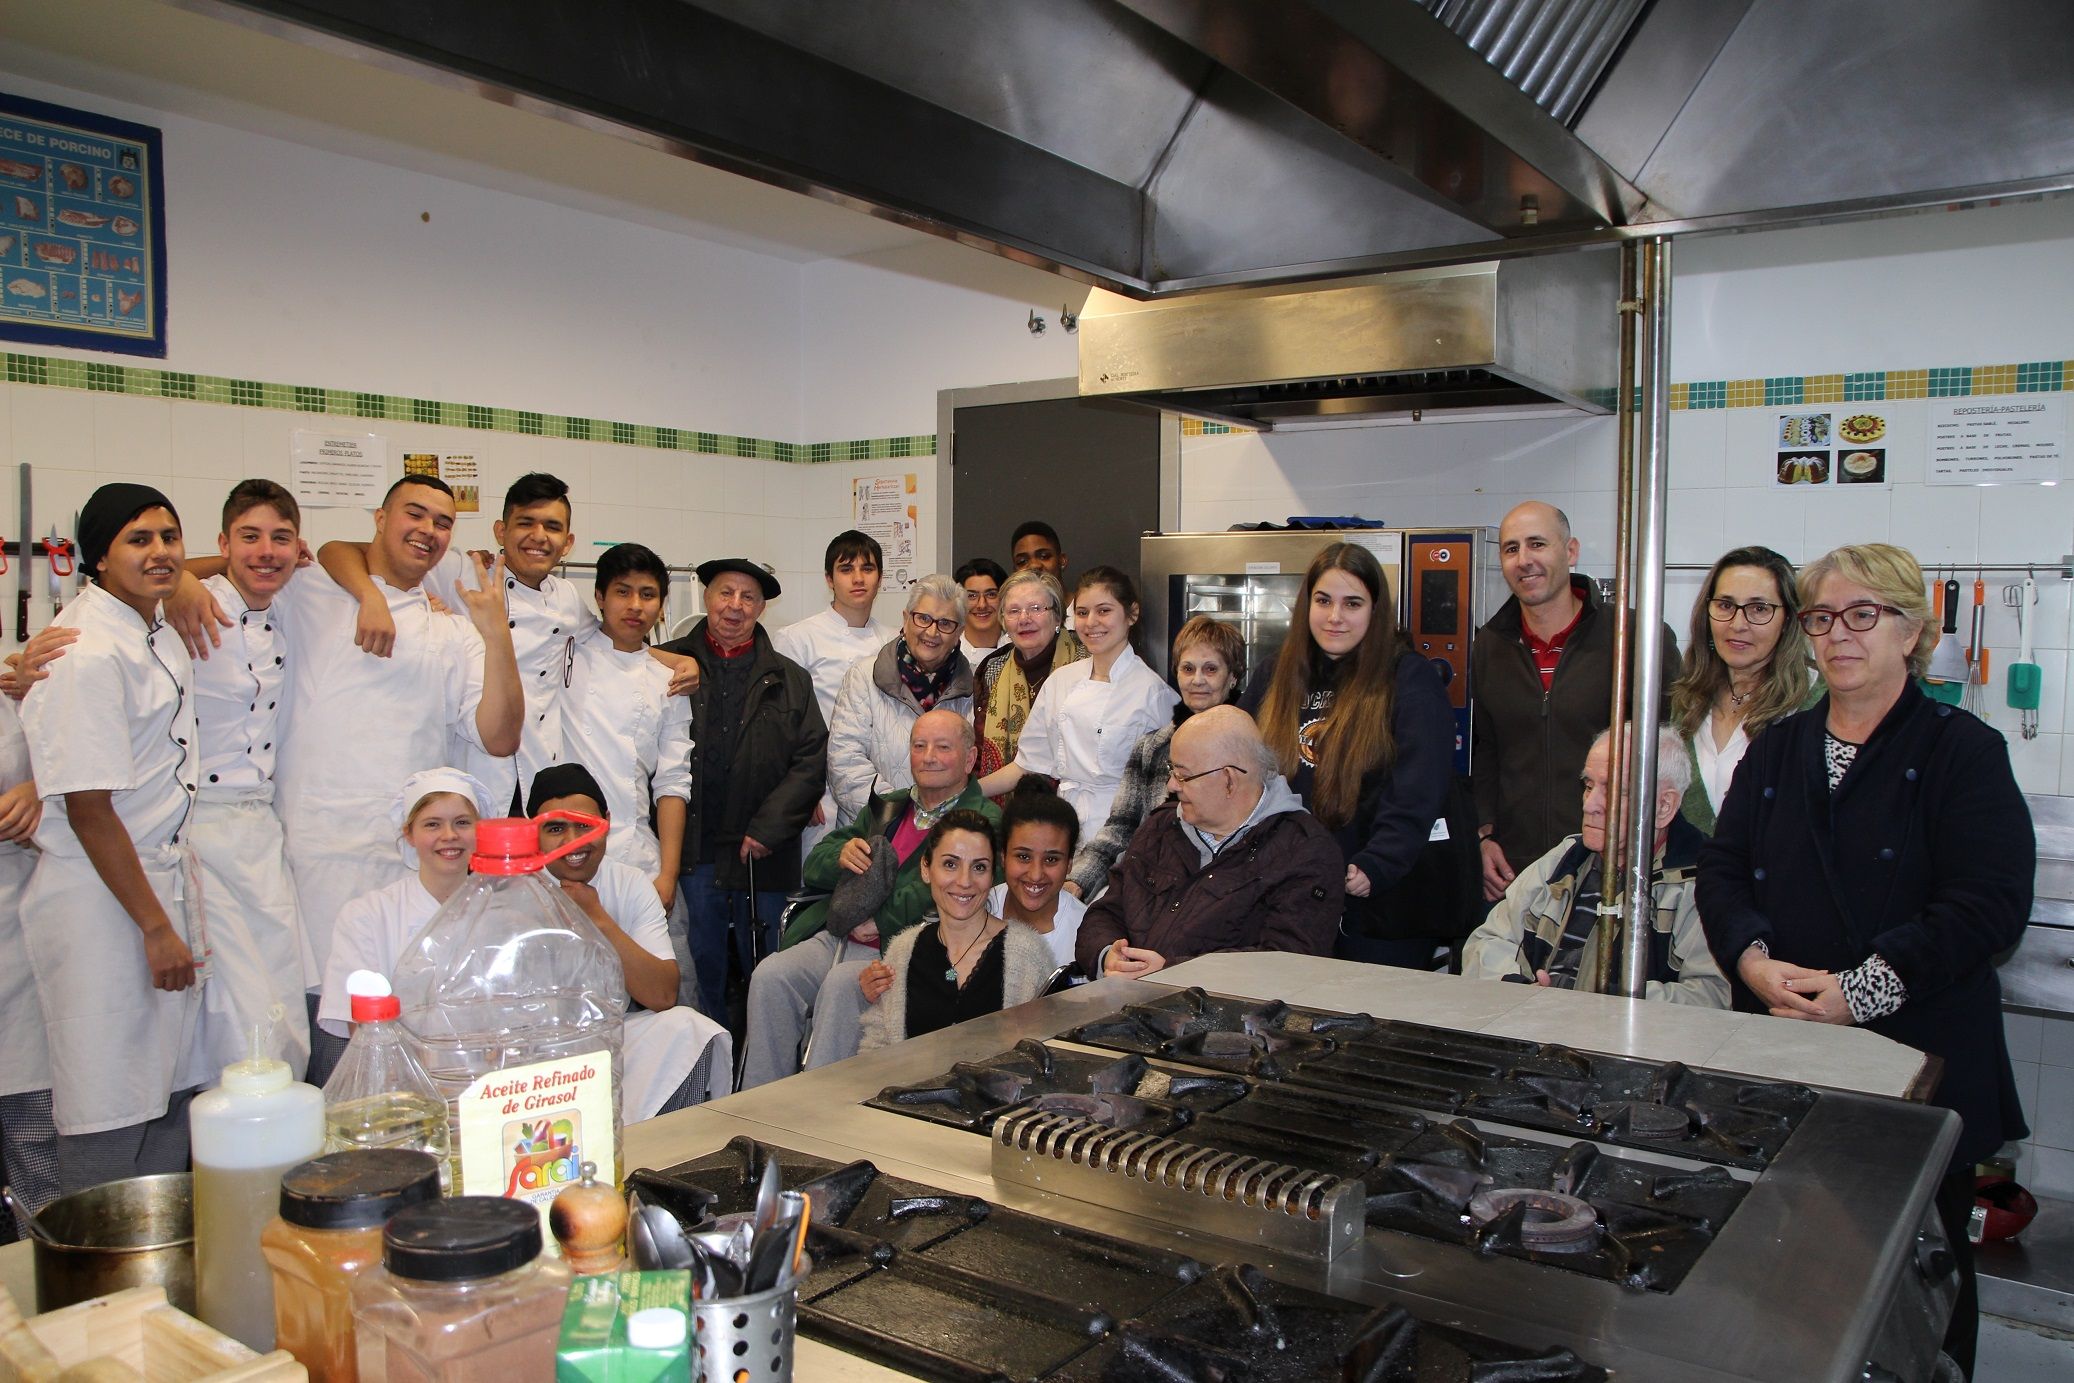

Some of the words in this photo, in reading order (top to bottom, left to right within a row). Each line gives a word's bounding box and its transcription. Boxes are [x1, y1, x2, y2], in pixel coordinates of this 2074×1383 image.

[27, 133, 45, 146] DE
[49, 137, 111, 159] PORCINO
[1953, 403, 2046, 415] REPOSTERÍA-PASTELERÍA
[480, 1079, 528, 1100] Aceite
[533, 1065, 595, 1091] Refinado
[502, 1099, 520, 1115] de
[524, 1087, 577, 1111] Girasol
